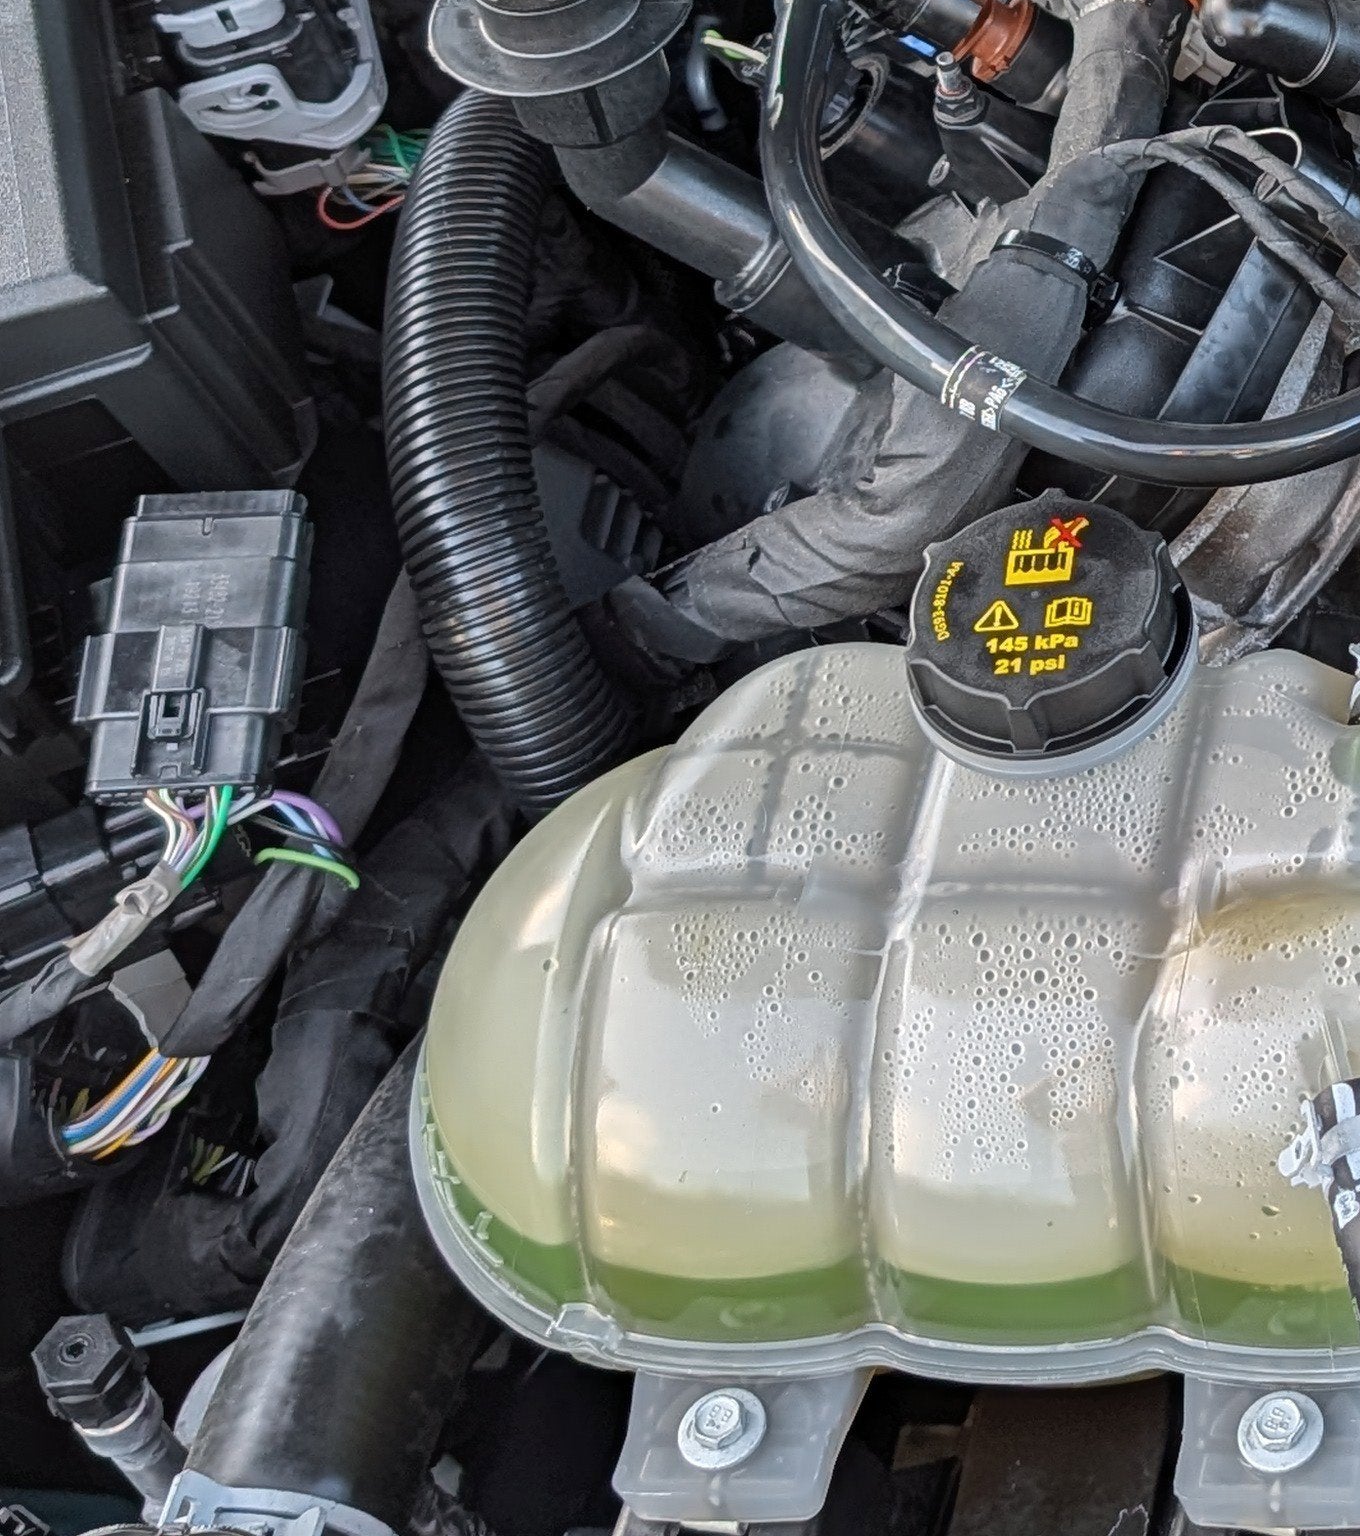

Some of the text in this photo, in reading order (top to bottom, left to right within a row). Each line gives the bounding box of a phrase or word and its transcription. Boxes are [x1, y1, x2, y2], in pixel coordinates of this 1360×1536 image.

[985, 633, 1080, 655] 145 kPa
[993, 653, 1067, 677] 21 psi
